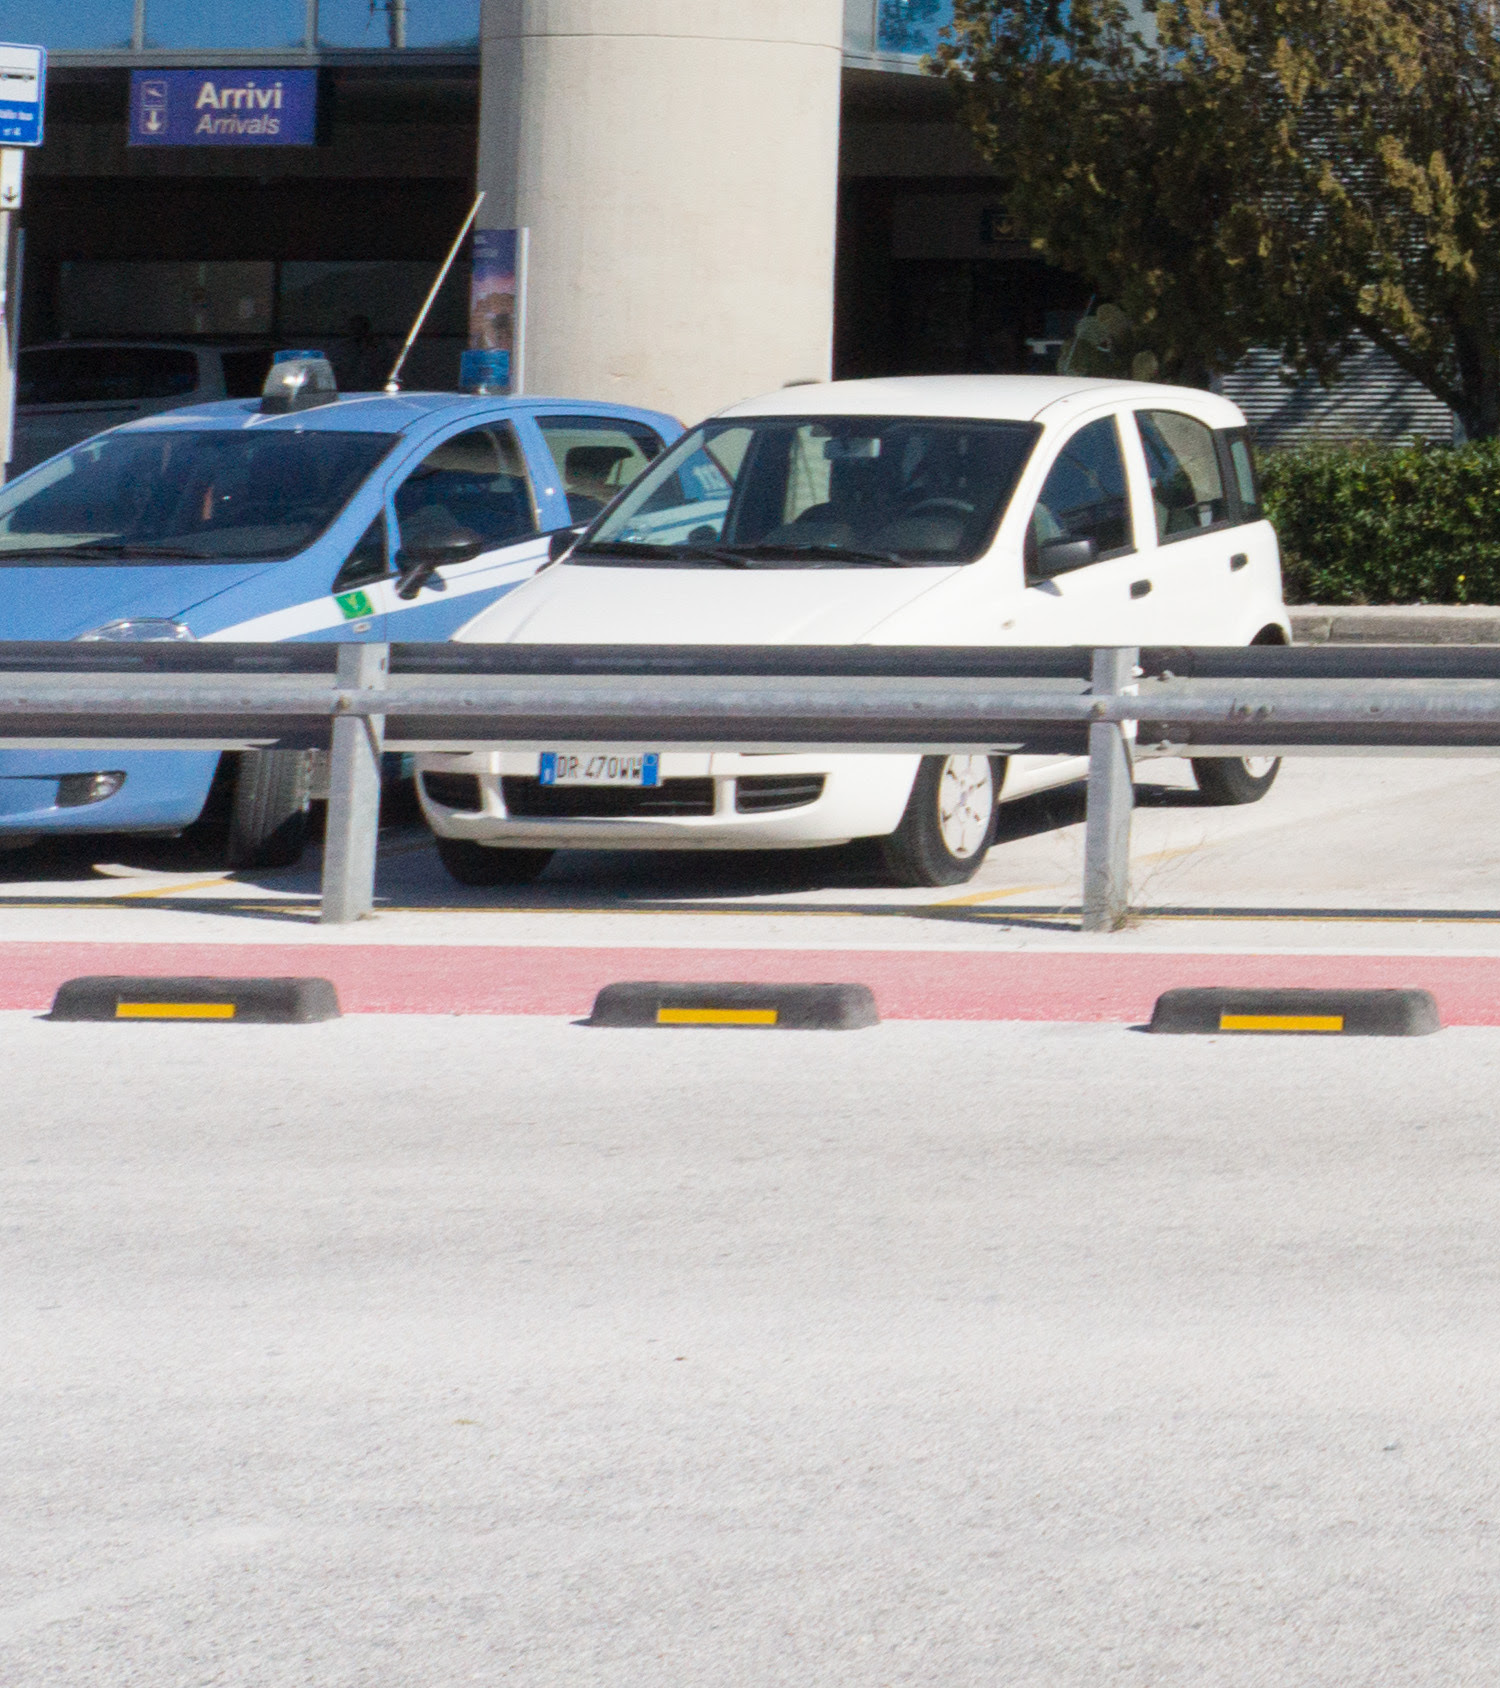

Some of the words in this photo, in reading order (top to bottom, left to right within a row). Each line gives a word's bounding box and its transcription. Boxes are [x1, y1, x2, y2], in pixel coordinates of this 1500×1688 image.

[195, 81, 283, 110] Arrivi
[195, 113, 281, 135] Arrivals
[556, 755, 579, 779] DR
